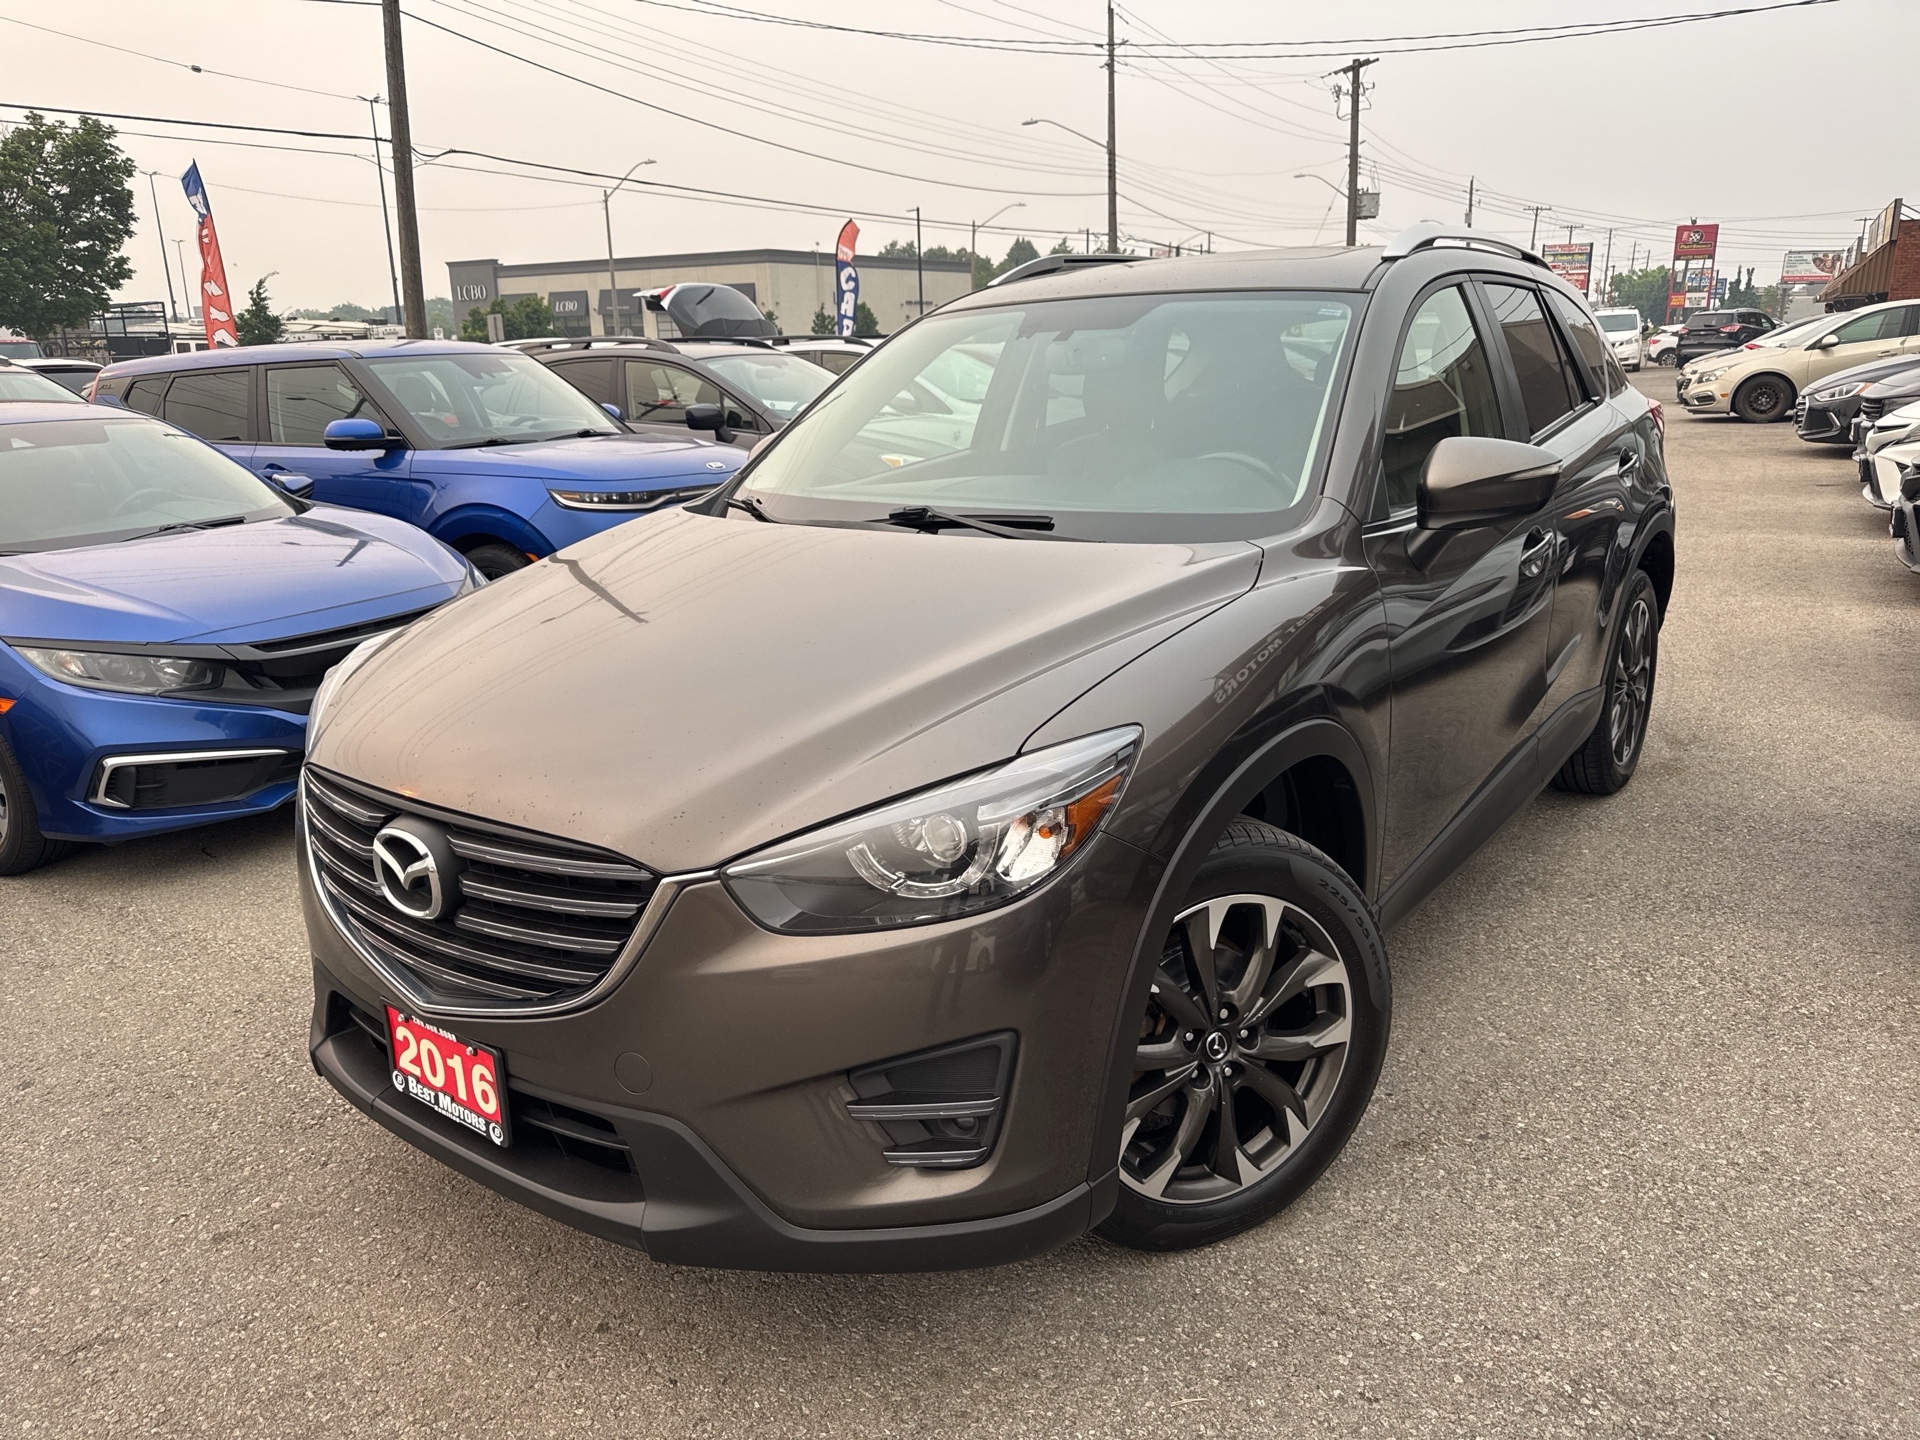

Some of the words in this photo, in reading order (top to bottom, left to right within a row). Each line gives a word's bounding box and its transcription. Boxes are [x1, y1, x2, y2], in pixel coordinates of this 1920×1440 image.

[457, 284, 487, 301] LCBO
[555, 301, 578, 312] LCBO
[1317, 878, 1371, 941] 225/55
[396, 1026, 497, 1115] 2016
